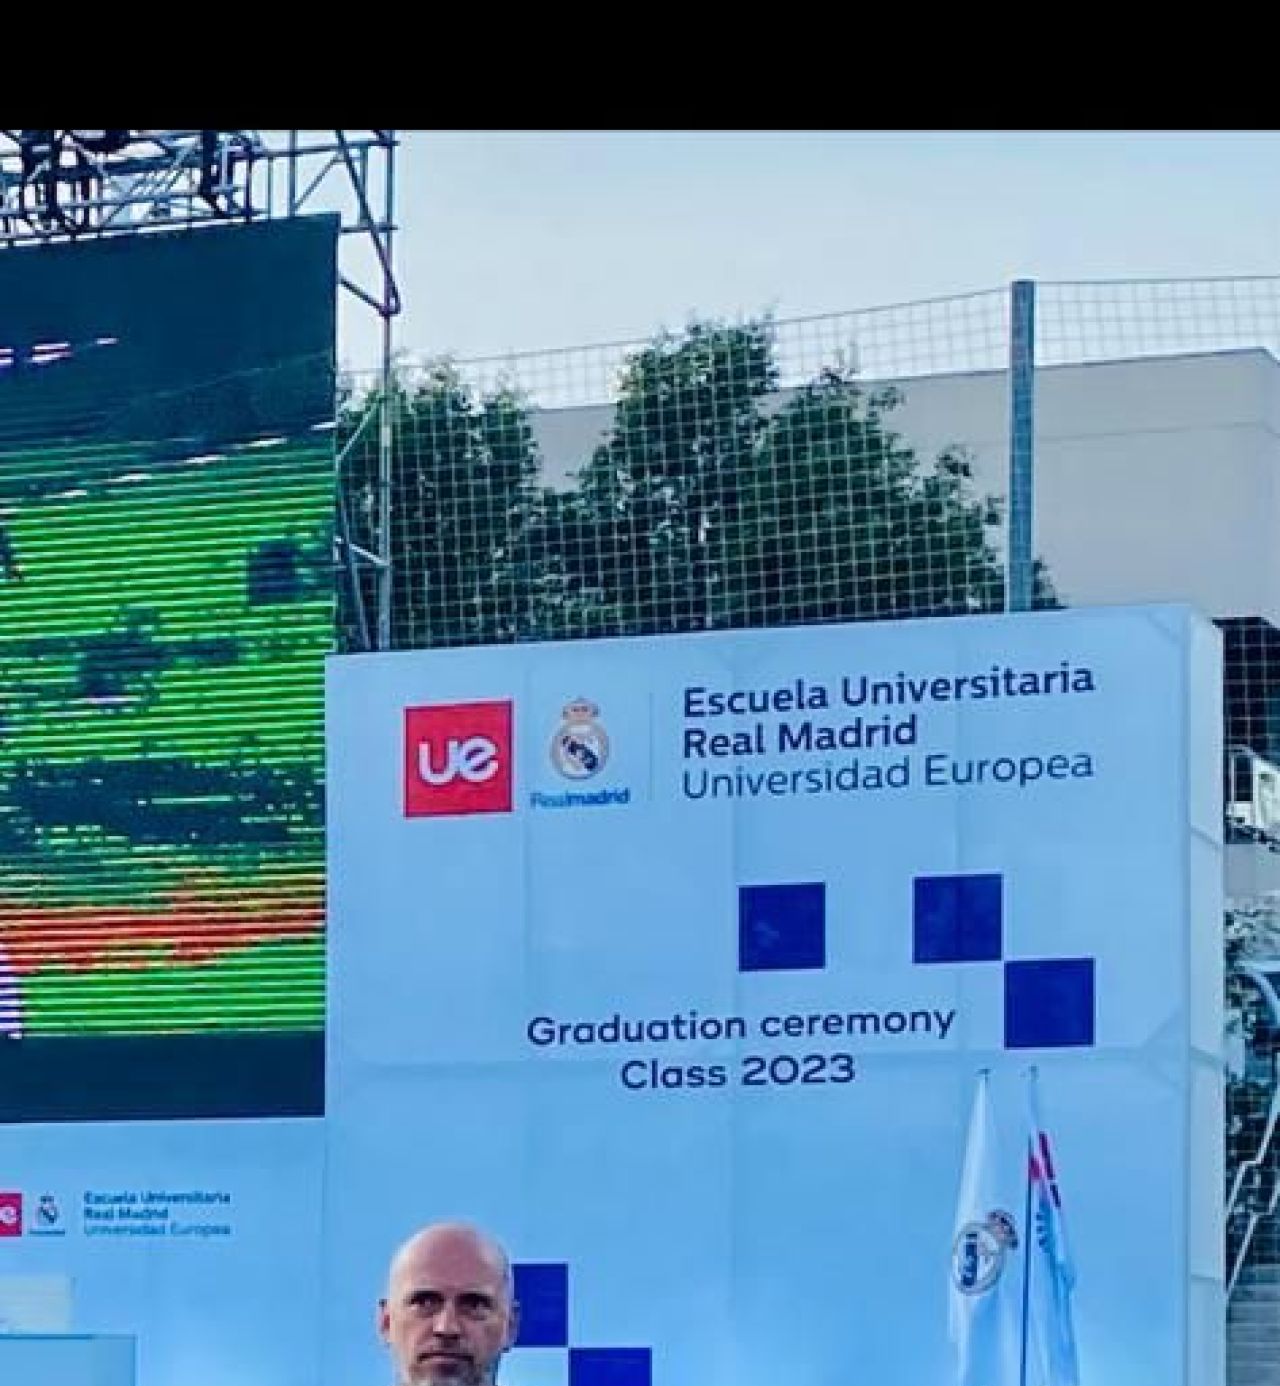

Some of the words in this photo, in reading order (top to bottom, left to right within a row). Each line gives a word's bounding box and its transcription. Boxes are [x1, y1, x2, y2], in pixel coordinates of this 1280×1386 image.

[684, 678, 829, 718] Escuela
[842, 660, 1097, 707] Universitaria
[684, 722, 766, 758] Real
[778, 713, 918, 753] Madrid
[417, 737, 499, 785] ue
[684, 754, 910, 800] Universidad
[924, 752, 1095, 789] Europea
[527, 1011, 746, 1046] Graduation
[760, 1009, 956, 1040] ceremony
[620, 1058, 728, 1090] Class
[741, 1053, 856, 1086] 2023
